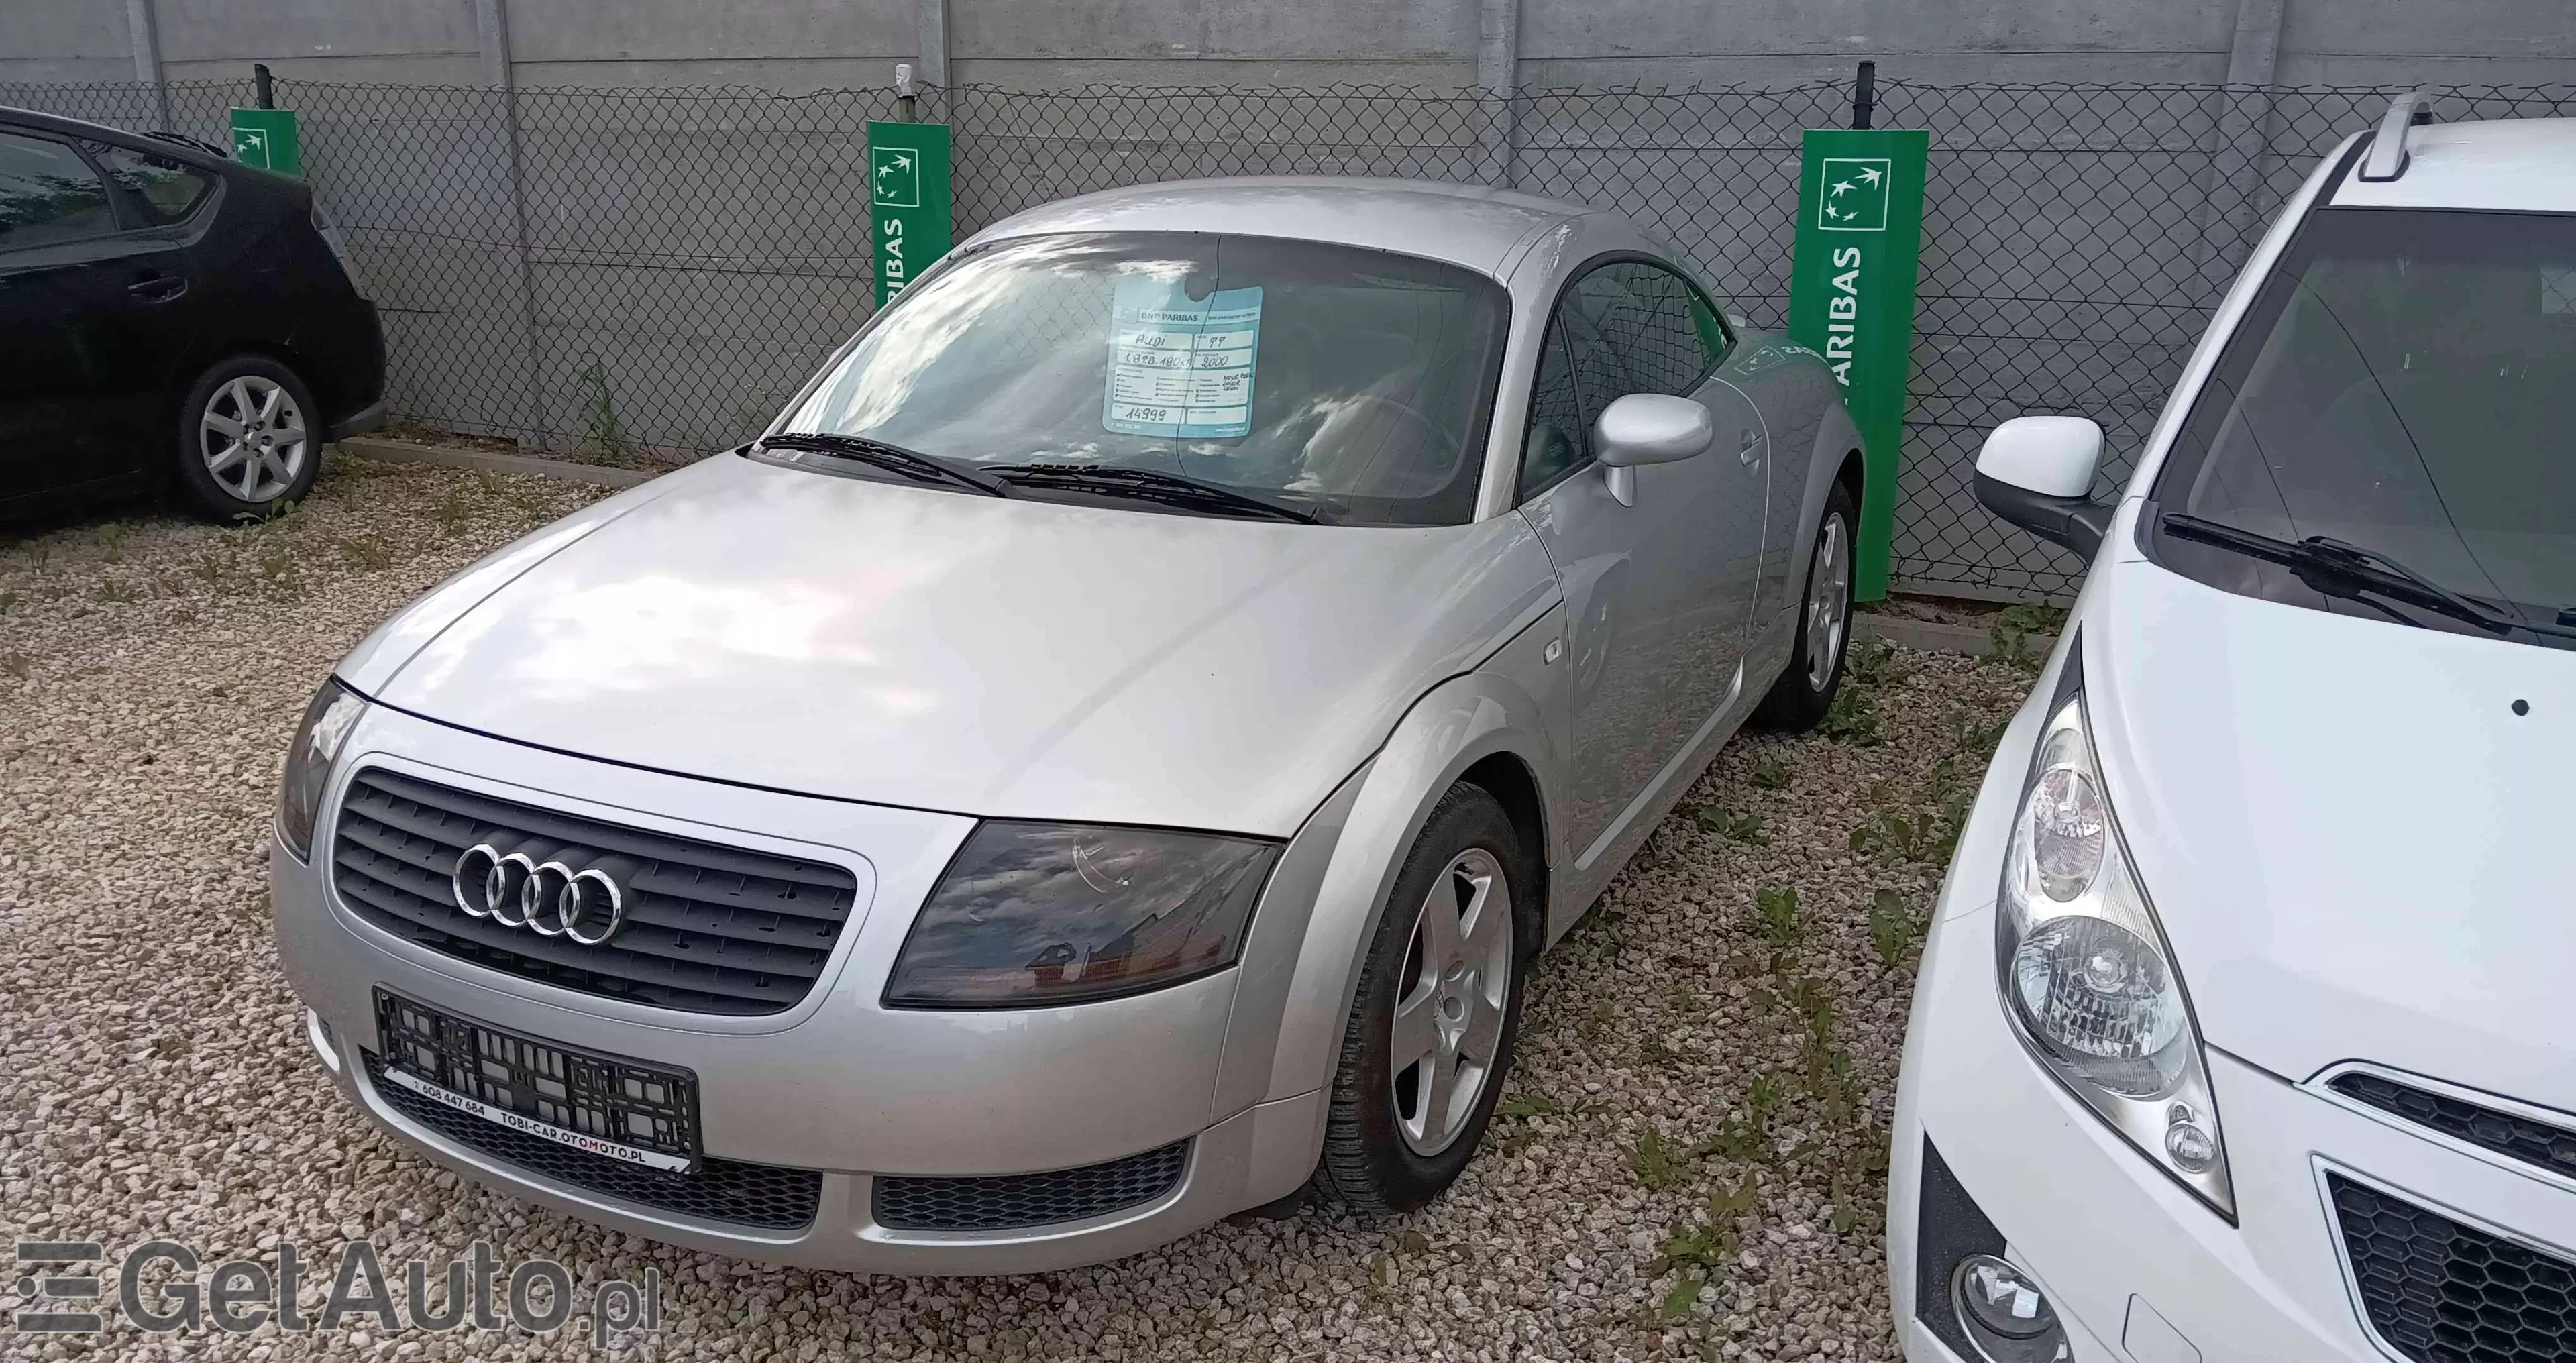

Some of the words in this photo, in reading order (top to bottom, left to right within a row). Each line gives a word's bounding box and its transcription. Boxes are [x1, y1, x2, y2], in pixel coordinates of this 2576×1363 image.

[1162, 313, 1198, 321] PARIBAS
[1826, 247, 1861, 406] ARIBAS
[1201, 356, 1228, 367] 2000
[1126, 408, 1166, 421] 14999
[423, 1085, 441, 1099] 608
[444, 1093, 463, 1107] 447
[465, 1102, 485, 1115] 684
[500, 1112, 646, 1162] TOBI-CAR.OTOMOTO.PL
